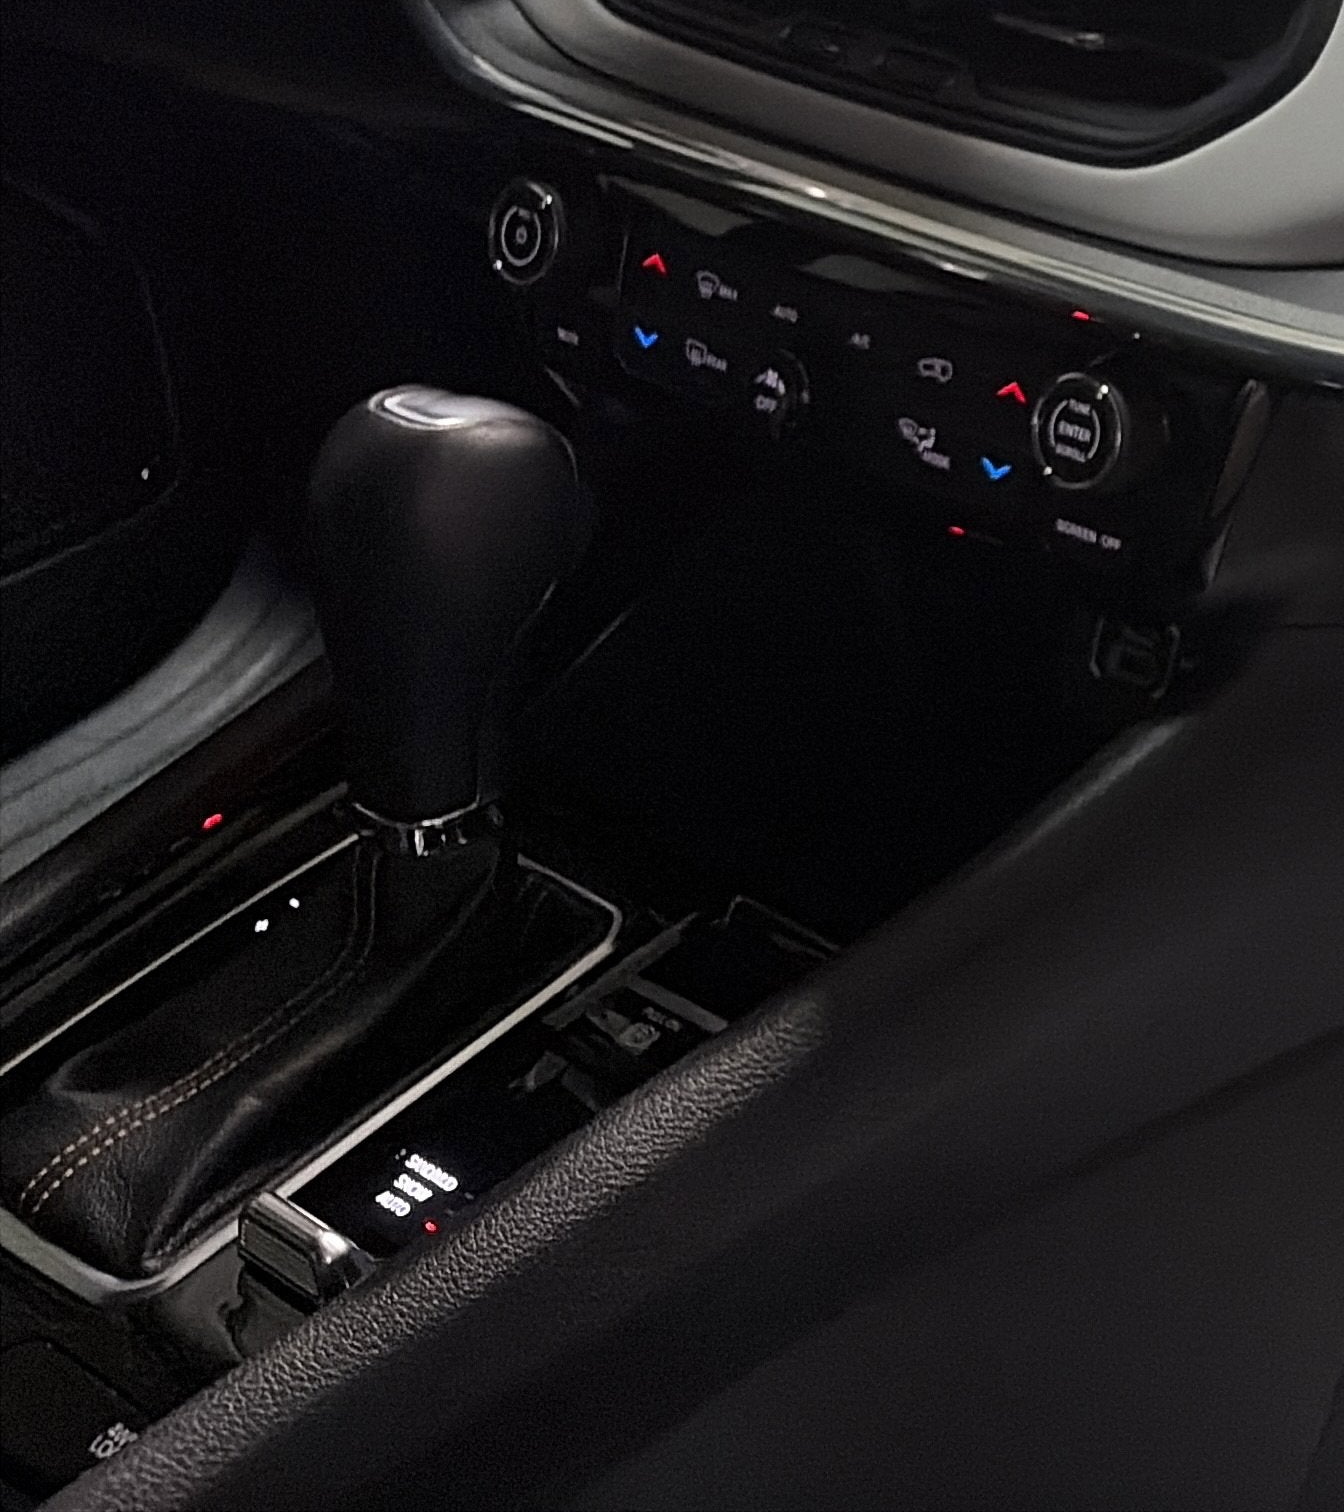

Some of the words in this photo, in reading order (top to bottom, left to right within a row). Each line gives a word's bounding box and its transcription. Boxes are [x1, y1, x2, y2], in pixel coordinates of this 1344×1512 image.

[1056, 418, 1093, 443] ENTER
[1054, 517, 1097, 544] SCREEN
[1099, 533, 1123, 551] OFF
